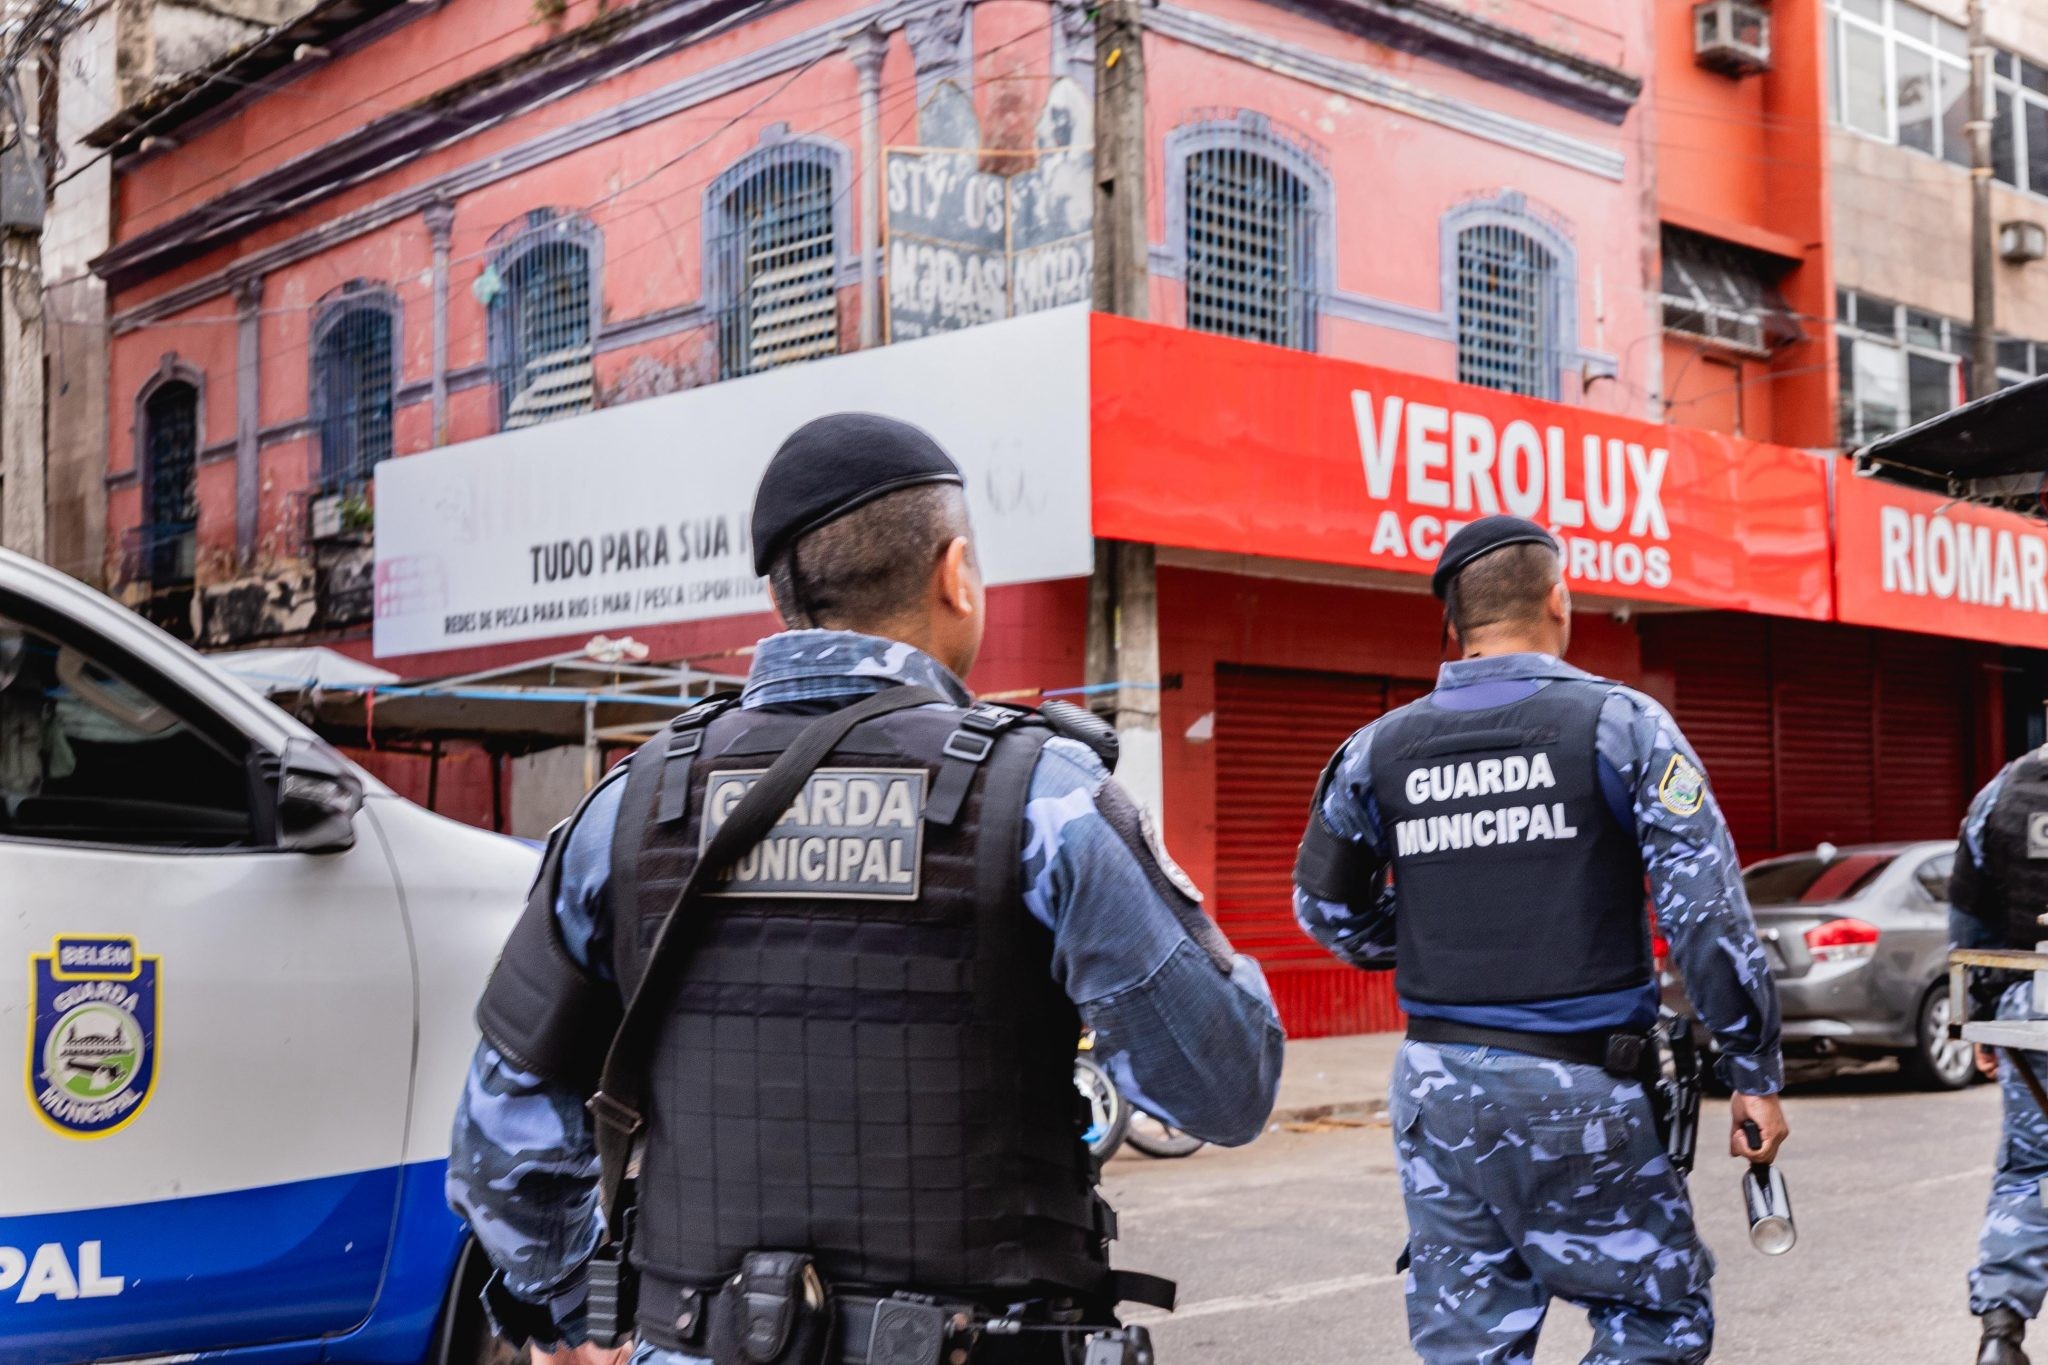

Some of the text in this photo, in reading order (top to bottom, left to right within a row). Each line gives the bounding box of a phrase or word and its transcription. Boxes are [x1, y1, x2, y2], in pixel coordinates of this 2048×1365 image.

[1351, 388, 1671, 541] VEROLUX
[530, 537, 593, 584] TUDO
[601, 523, 669, 574] PARA
[679, 512, 729, 564] SUA
[444, 611, 476, 635] REDES
[479, 608, 492, 630] DE
[495, 604, 528, 628] PESCA
[532, 600, 563, 623] PARA
[568, 596, 588, 618] RIO
[602, 591, 631, 614] MAR
[645, 583, 684, 608] PESCA
[710, 779, 914, 828] GARDA
[1405, 752, 1556, 805] GUARDA
[1396, 802, 1578, 857] MUNICIPAL
[716, 837, 913, 884] UNICIPAL
[53, 981, 139, 1013] GUARDA
[38, 1084, 144, 1124] MUNICIPAL
